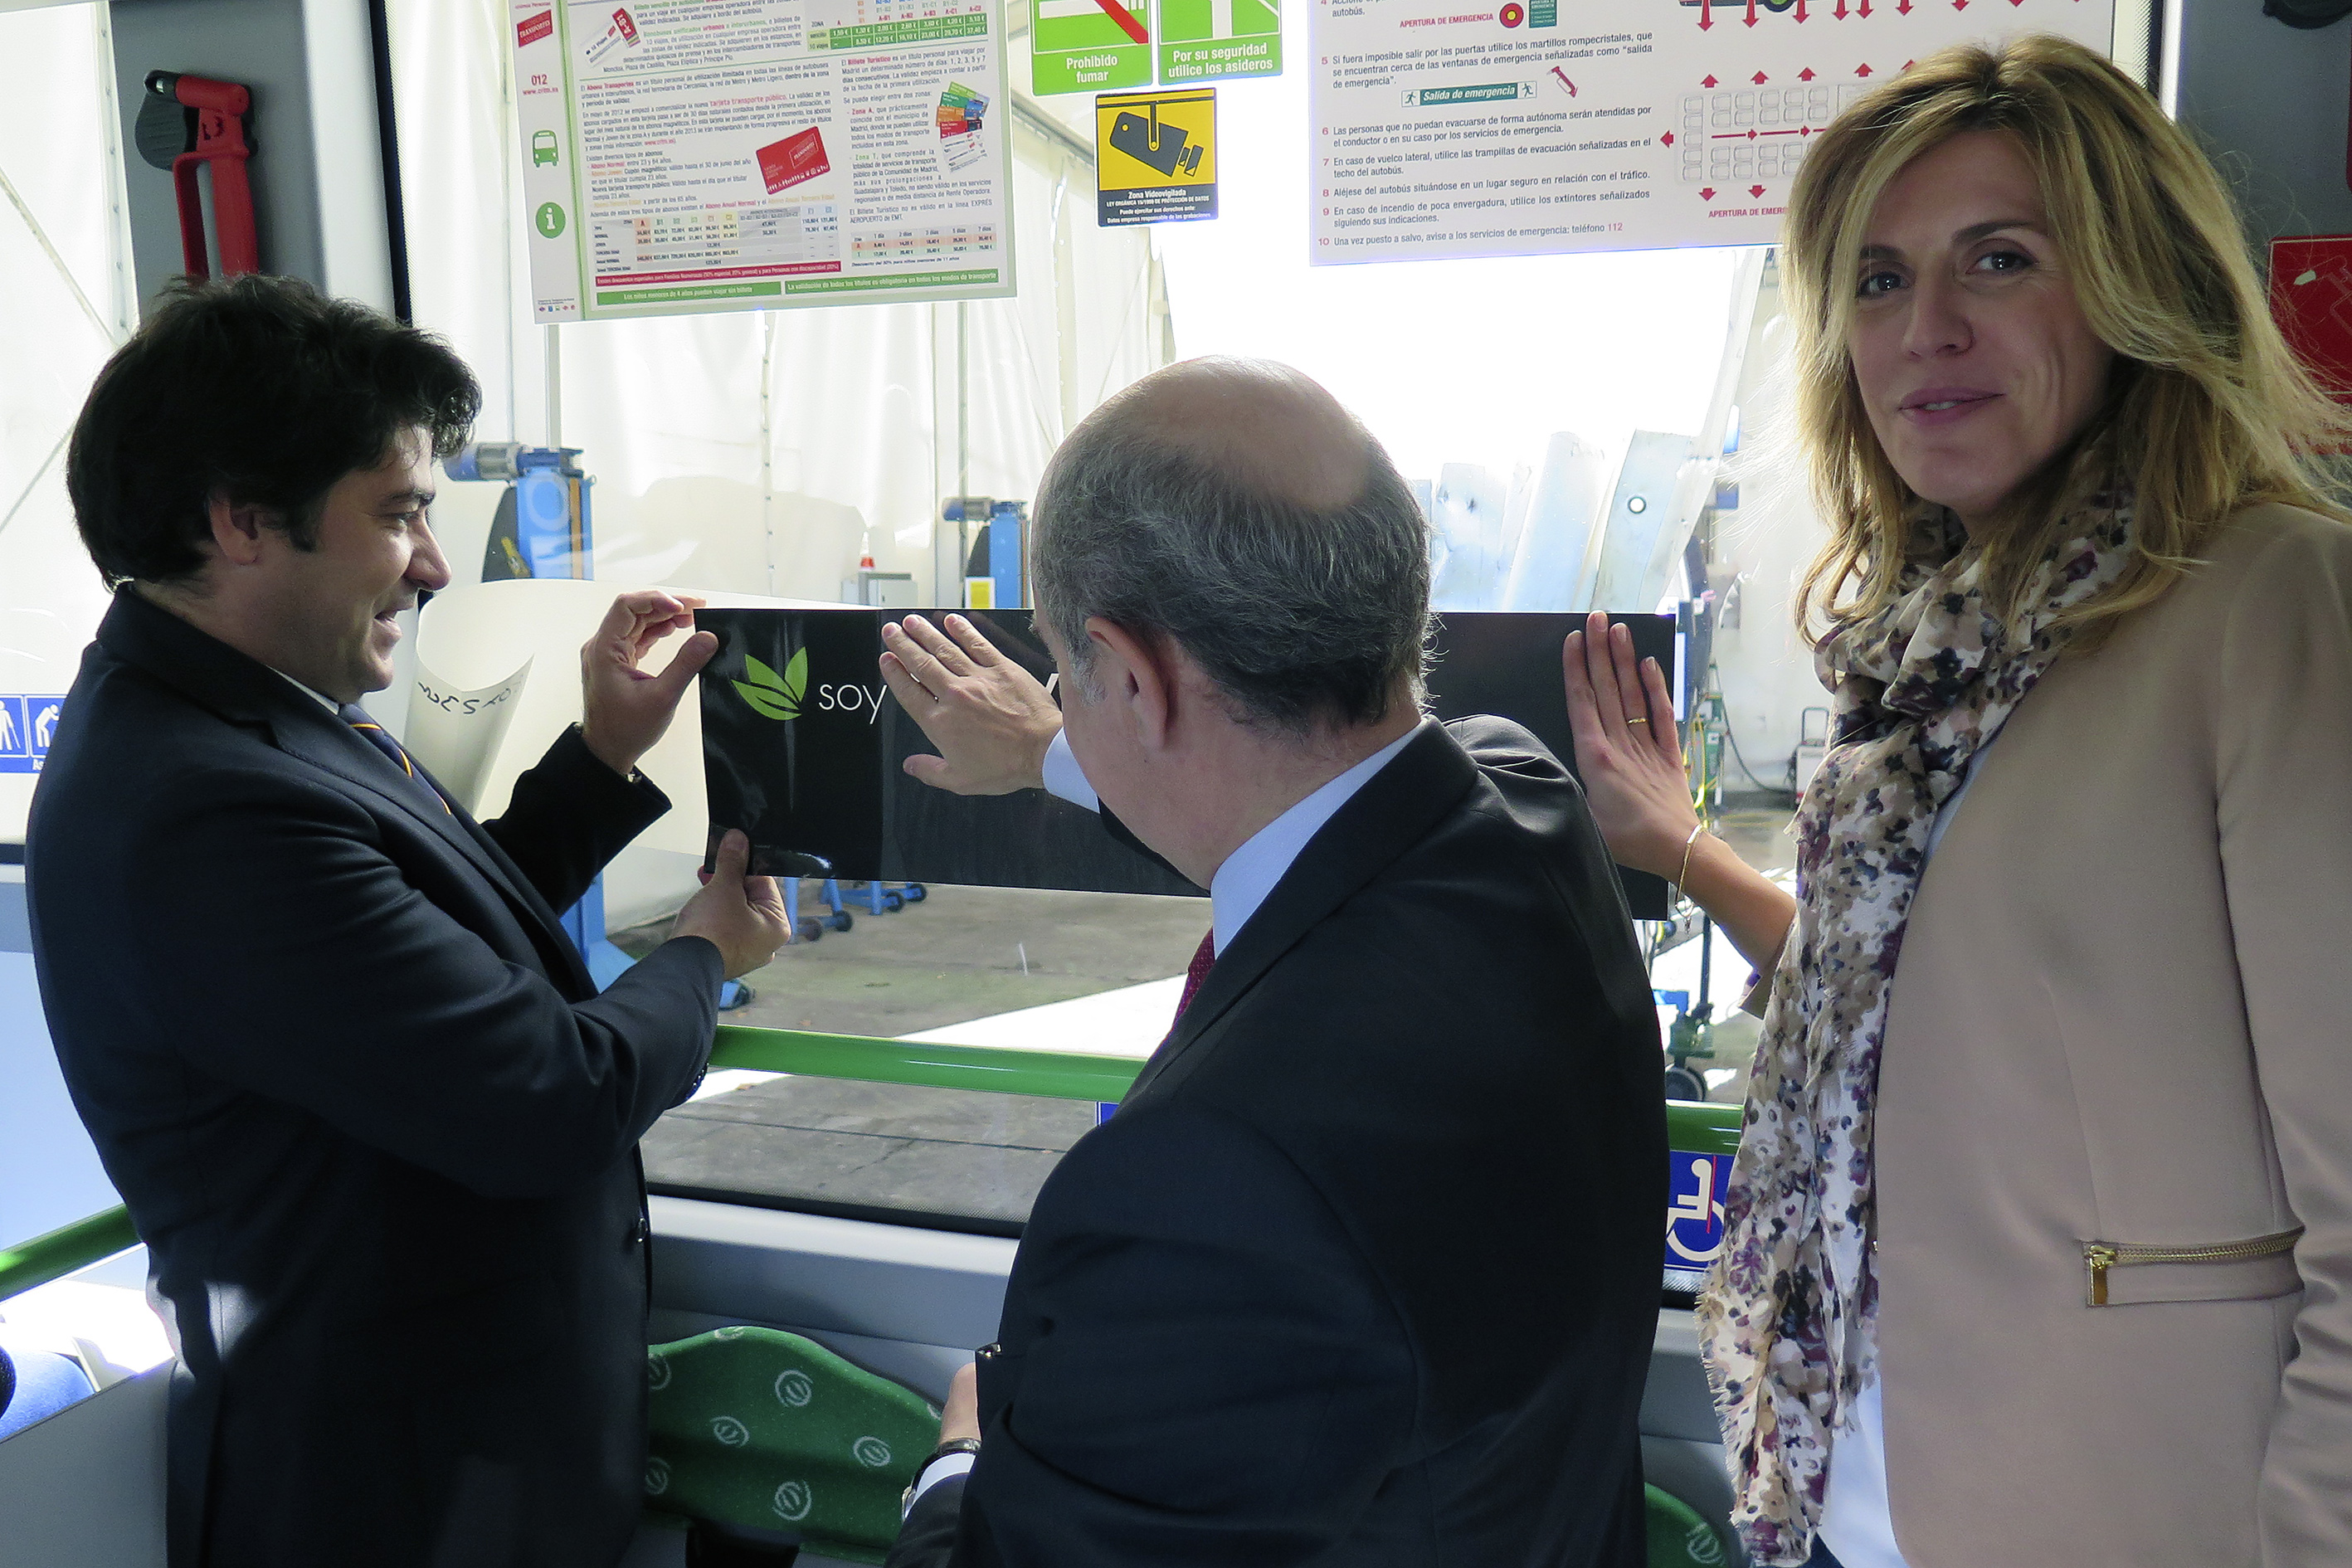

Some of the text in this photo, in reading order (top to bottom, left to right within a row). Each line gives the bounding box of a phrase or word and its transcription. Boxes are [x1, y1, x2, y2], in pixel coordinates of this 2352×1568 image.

[1332, 7, 1365, 17] autobús.
[1400, 12, 1493, 27] APERTURA DE EMERGENCIA
[1173, 41, 1267, 62] Por su seguridad
[1322, 32, 1652, 65] 5 Si fuera imposible salir por las puertas utilice los martillos rompecristales, que
[1066, 54, 1118, 70] Prohibido
[1168, 58, 1273, 77] utilice los asideros
[1344, 65, 1388, 75] encuentran
[1390, 63, 1412, 72] cerca
[1415, 61, 1424, 70] de
[1427, 61, 1439, 69] las
[1441, 58, 1478, 68] ventanas
[1481, 56, 1491, 65] de
[1493, 51, 1541, 65] emergencia
[1545, 48, 1593, 60] señalizadas
[1596, 47, 1619, 56] como
[1622, 43, 1652, 54] "salida
[531, 74, 548, 85] 012
[1076, 71, 1108, 83] fumar
[1332, 75, 1396, 89] de emergencia".
[1423, 85, 1515, 100] Salida de emergencia
[1322, 127, 1328, 135] 6
[1333, 126, 1346, 134] Las
[1348, 124, 1383, 135] personas
[1385, 124, 1400, 133] que
[1414, 119, 1443, 131] puedan
[1445, 118, 1485, 127] evacuarse
[1488, 115, 1497, 124] de
[1500, 114, 1524, 124] forma
[1526, 112, 1566, 122] autónoma
[1569, 109, 1592, 119] serán
[1595, 106, 1635, 117] atendidas
[1637, 106, 1652, 116] por
[1333, 139, 1340, 147] el
[1342, 137, 1381, 146] conductor
[1413, 134, 1432, 142] caso
[1434, 133, 1447, 142] por
[1449, 130, 1461, 139] los
[1463, 128, 1498, 139] servicios
[1501, 127, 1511, 136] de
[1513, 124, 1563, 136] emergencia.
[1323, 158, 1329, 166] 7
[1333, 157, 1343, 166] En
[1366, 155, 1375, 163] de
[1377, 153, 1402, 163] vuelco
[1405, 151, 1432, 161] lateral,
[1434, 150, 1458, 159] utilice
[1461, 149, 1473, 158] las
[1475, 147, 1515, 158] trampillas
[1517, 145, 1527, 154] de
[1530, 142, 1576, 153] evacuación
[1579, 139, 1627, 150] señalizadas
[1643, 137, 1650, 146] el
[1333, 165, 1404, 178] techo del autobús.
[1322, 188, 1329, 197] 8
[1333, 187, 1361, 197] Aléjese
[1364, 186, 1376, 195] del
[1379, 183, 1410, 194] autobús
[1414, 182, 1457, 192] situándose
[1486, 179, 1507, 189] lugar
[1510, 178, 1538, 187] seguro
[1554, 173, 1588, 183] relación
[1590, 173, 1606, 182] con
[1609, 171, 1617, 181] el
[1620, 169, 1650, 179] tráfico.
[1322, 189, 1649, 216] 9 En caso de incendio de poca envergadura, utilice los extintores señalizados
[1333, 217, 1371, 229] siguiendo
[1388, 213, 1439, 224] indicaciones.
[1708, 209, 1747, 217] APERTURA
[1318, 237, 1329, 246] 10
[1334, 236, 1349, 246] Una
[1366, 235, 1391, 246] puesto
[1400, 233, 1424, 242] salvo,
[1425, 231, 1446, 241] avise
[1455, 231, 1467, 239] los
[1469, 229, 1505, 238] servicios
[1507, 227, 1517, 236] de
[1519, 225, 1569, 236] emergencia:
[1571, 223, 1605, 233] teléfono
[1608, 222, 1623, 231] 112
[818, 684, 888, 724] soy
